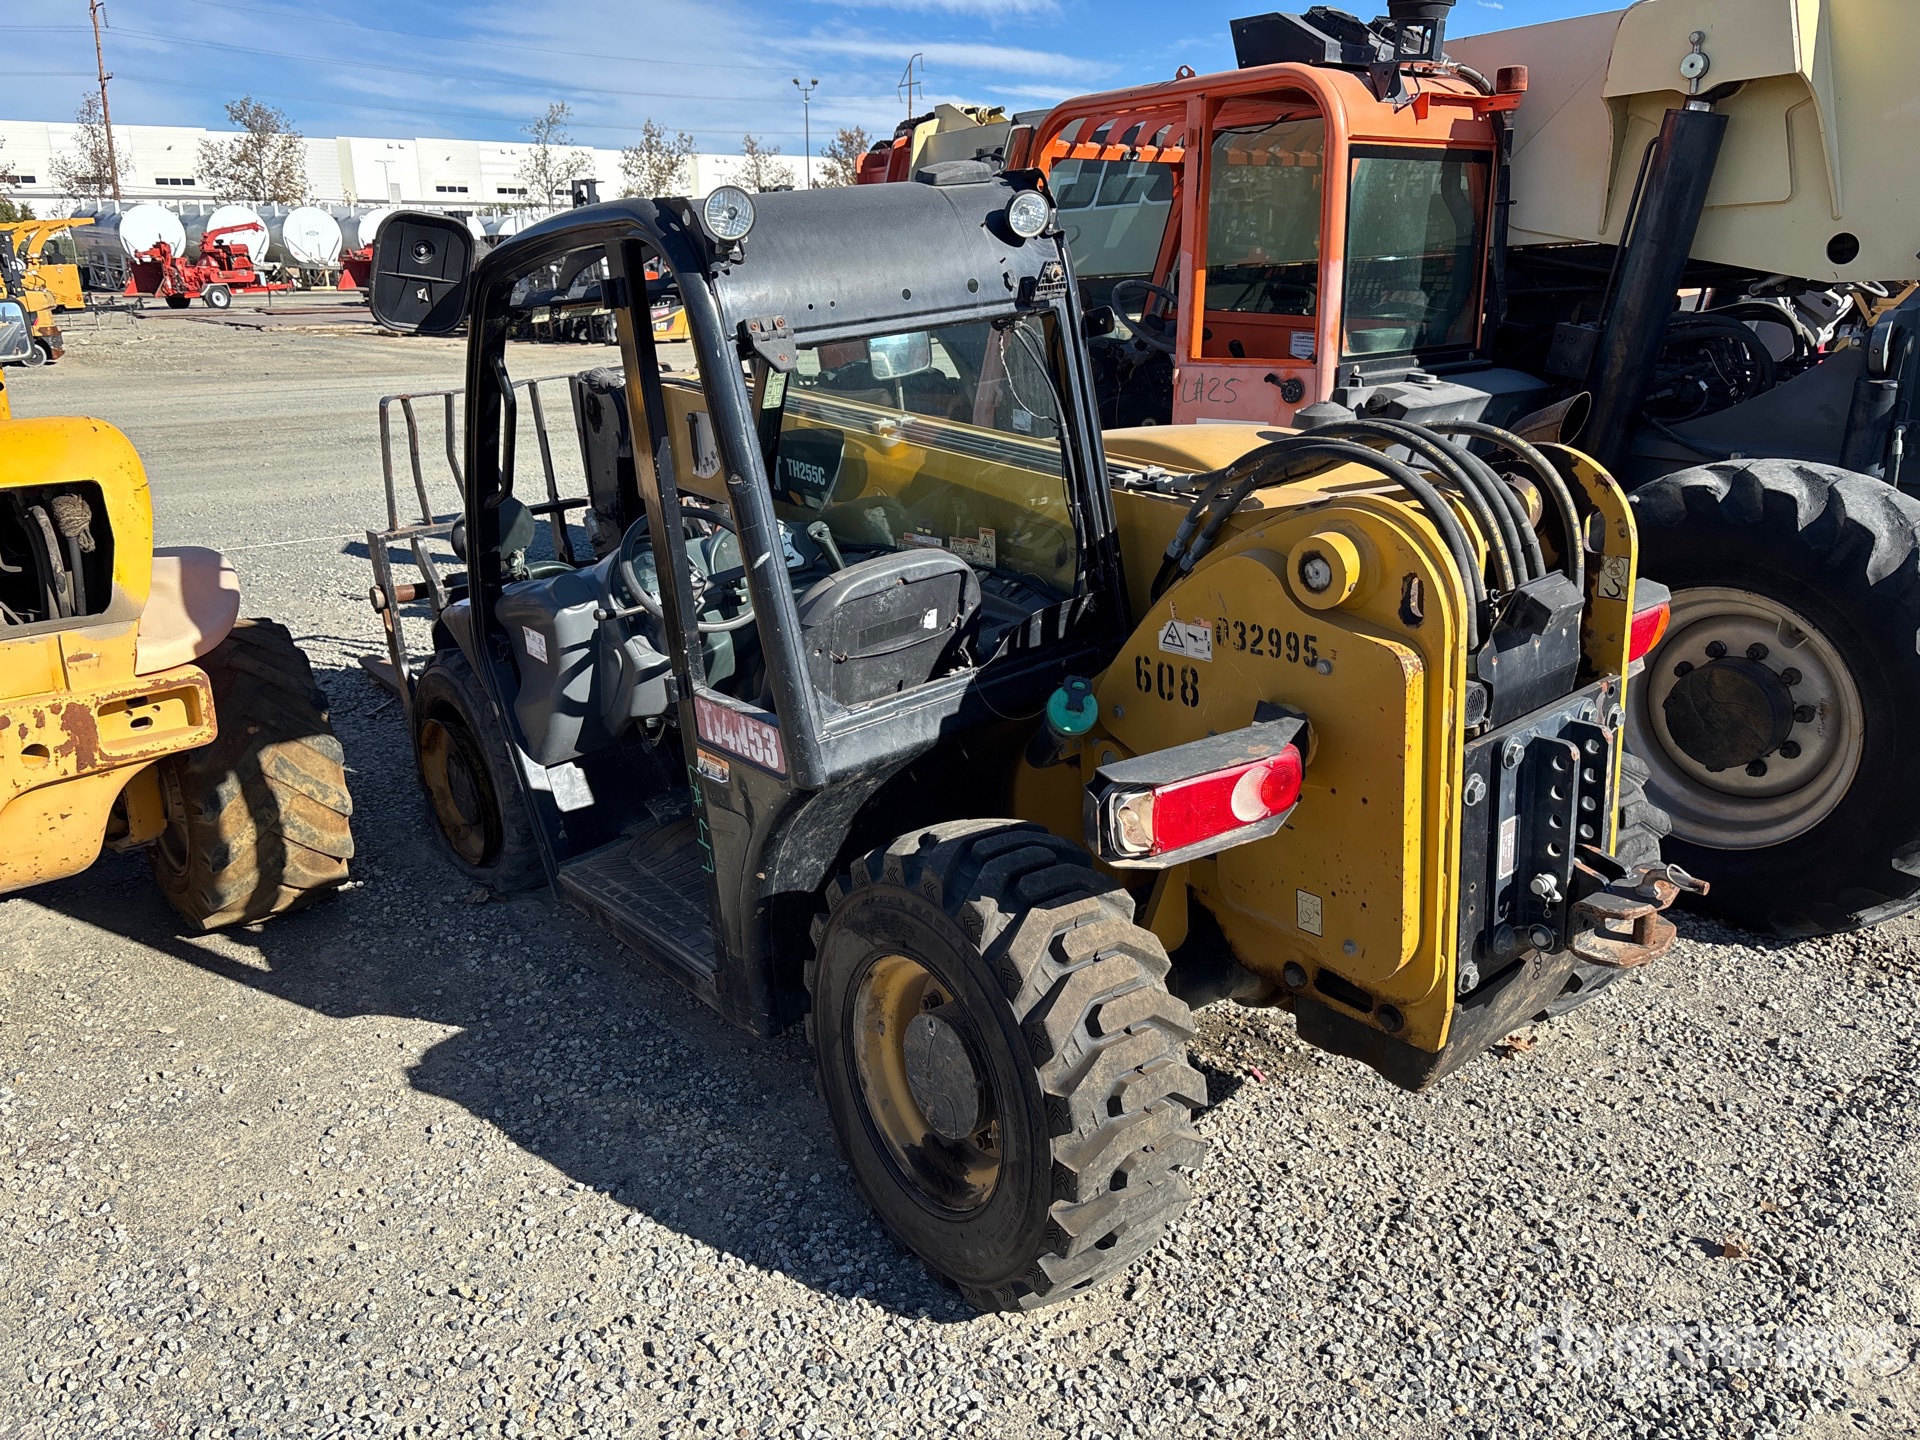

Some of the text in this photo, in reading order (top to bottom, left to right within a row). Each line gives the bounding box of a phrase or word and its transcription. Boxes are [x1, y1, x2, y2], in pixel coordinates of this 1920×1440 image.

[786, 457, 826, 486] TH255C
[1215, 616, 1319, 668] 032995
[1135, 655, 1199, 708] 608
